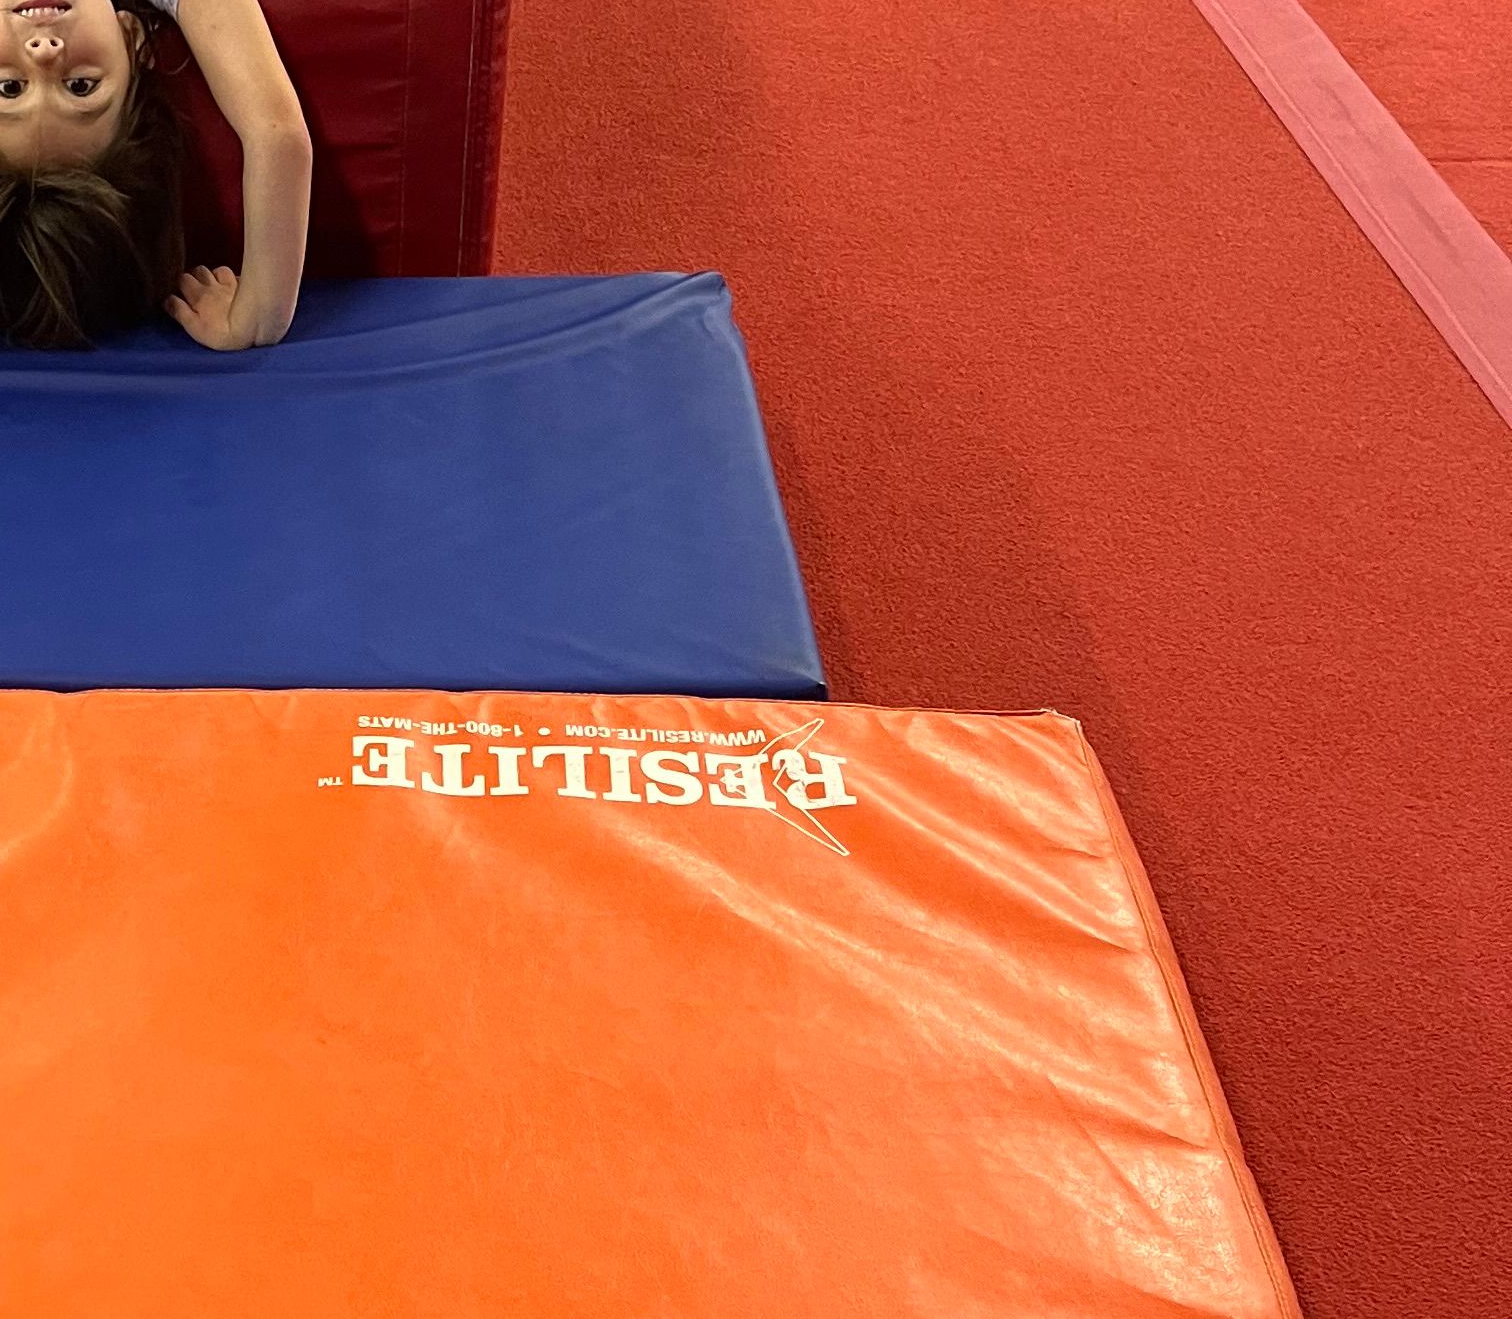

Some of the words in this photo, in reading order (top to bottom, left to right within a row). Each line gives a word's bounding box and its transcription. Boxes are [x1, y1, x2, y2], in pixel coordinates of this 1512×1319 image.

[357, 715, 524, 738] 1-800-THE-MATS
[565, 724, 766, 746] WWW.RESILITE.COM
[351, 735, 857, 810] RESILITE
